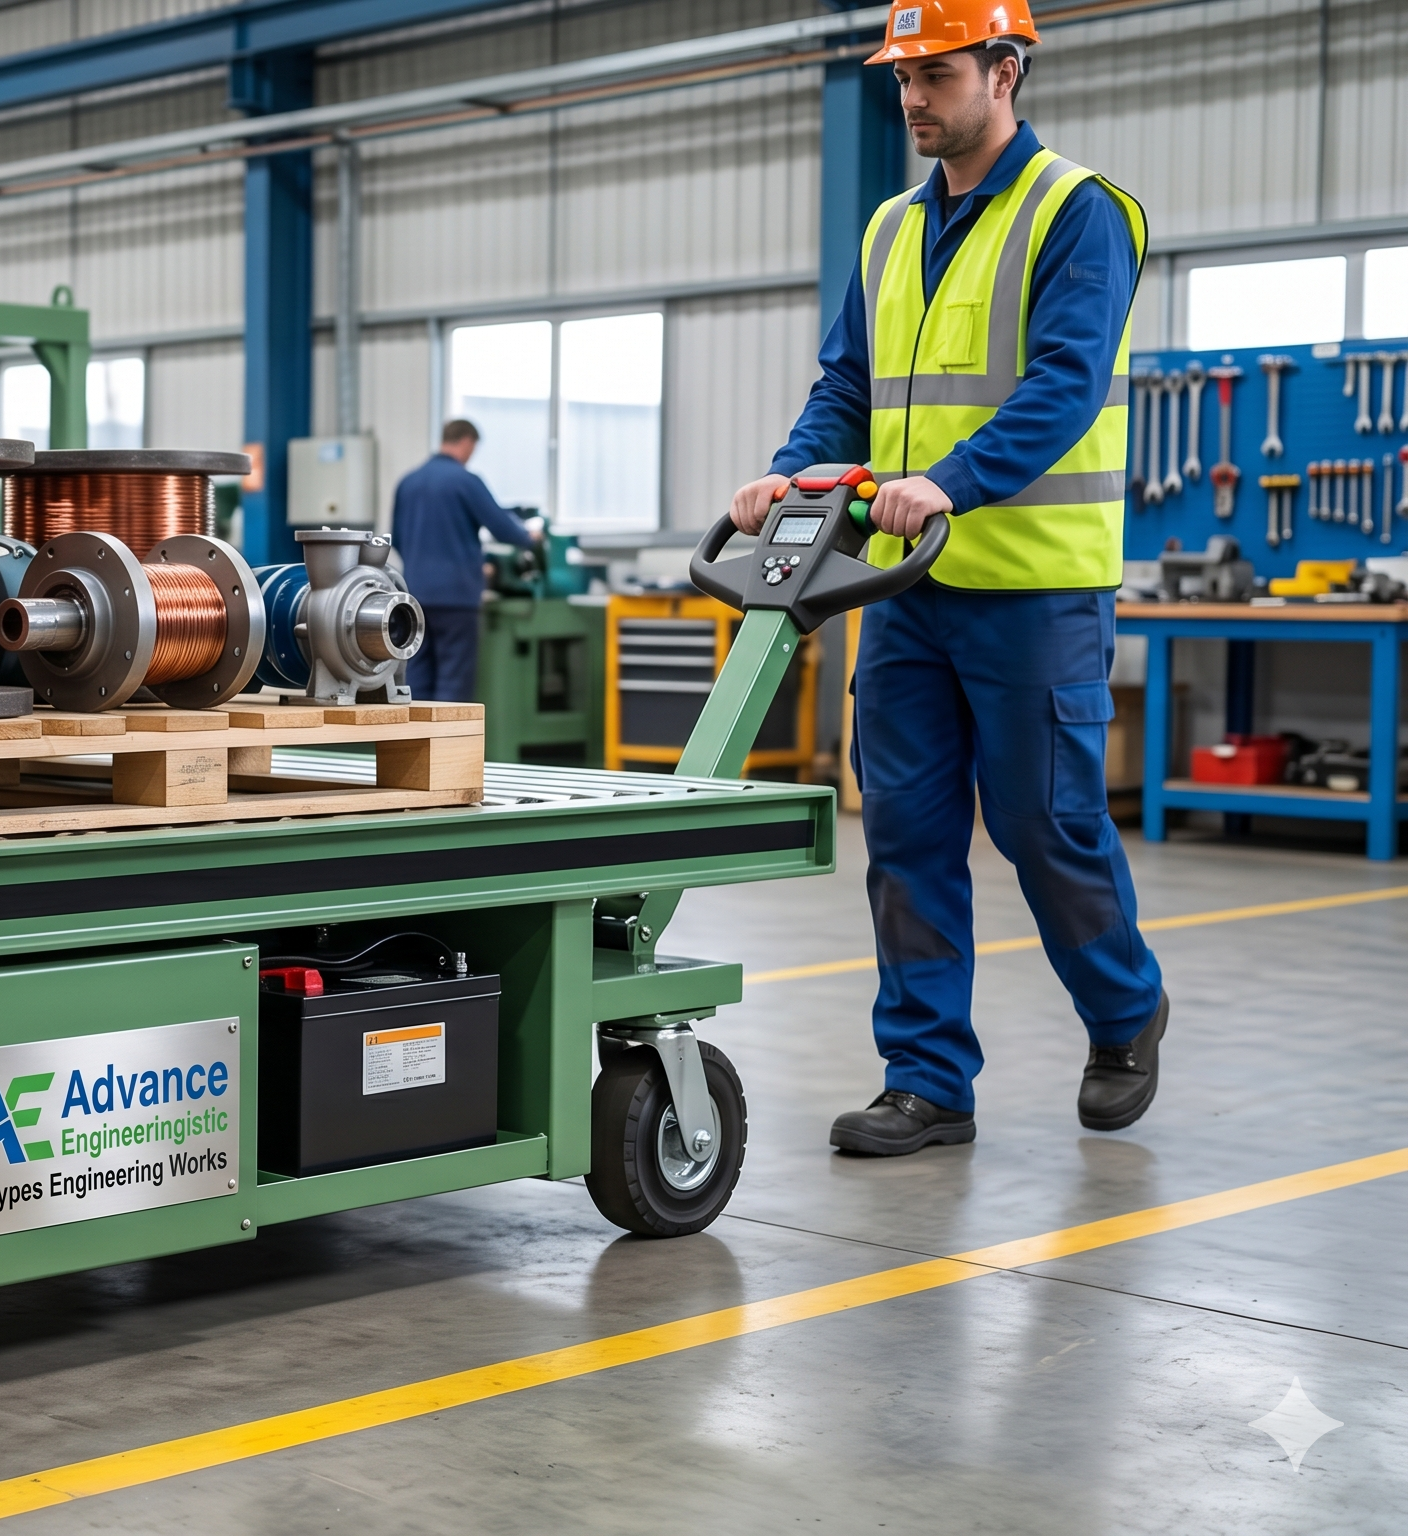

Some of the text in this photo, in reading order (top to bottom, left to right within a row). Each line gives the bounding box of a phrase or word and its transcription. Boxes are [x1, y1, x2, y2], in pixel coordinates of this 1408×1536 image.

[61, 1061, 229, 1119] Advance
[61, 1106, 229, 1159] Engineeringistic
[50, 1159, 164, 1199] Engineering
[168, 1147, 228, 1177] Works
